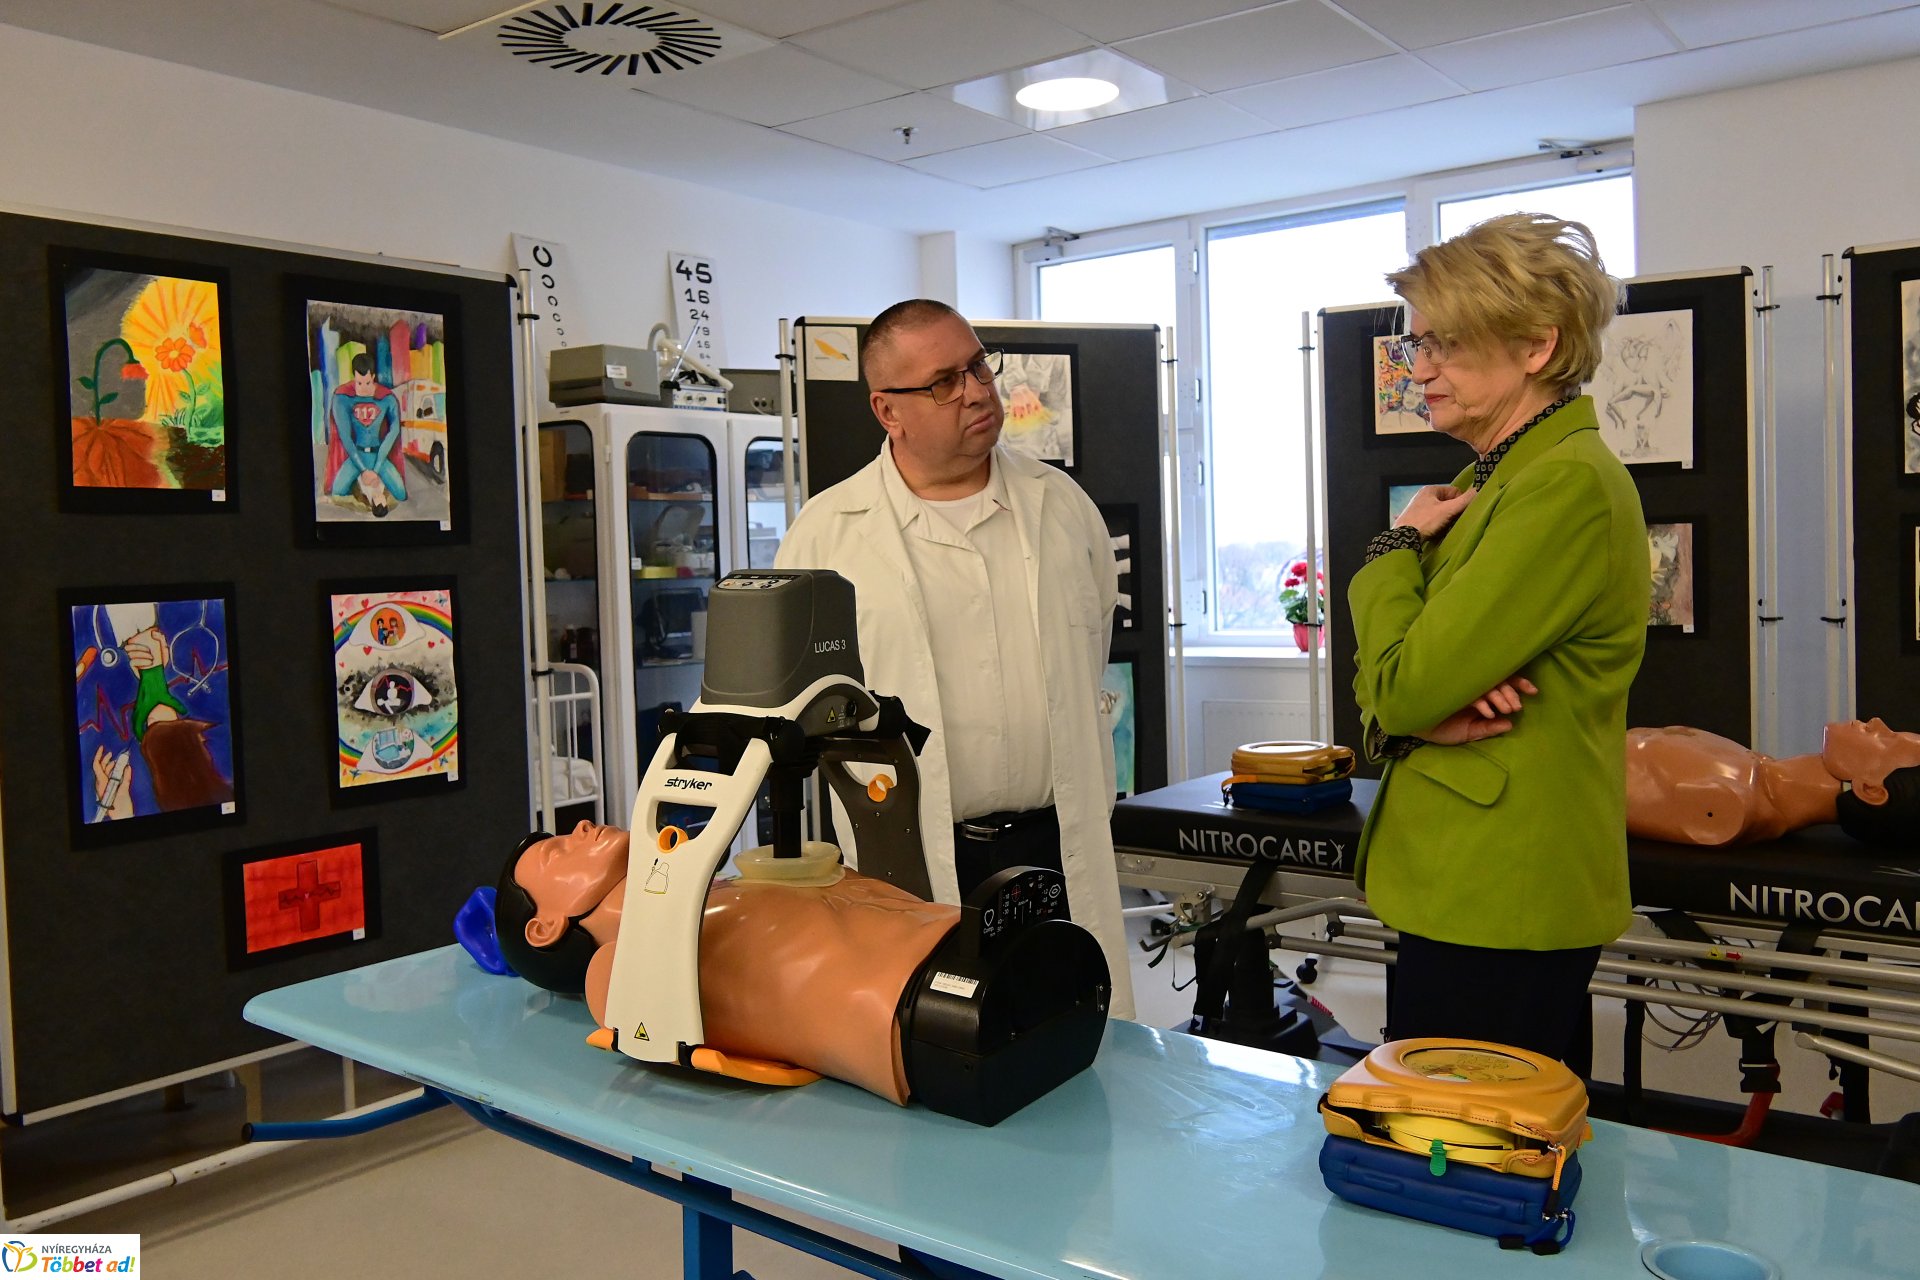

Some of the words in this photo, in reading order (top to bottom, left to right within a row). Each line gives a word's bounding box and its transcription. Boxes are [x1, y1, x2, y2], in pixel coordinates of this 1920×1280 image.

[675, 259, 713, 284] 45
[684, 288, 711, 305] 16
[689, 308, 710, 321] 24
[354, 406, 377, 420] 112
[814, 639, 841, 654] LUCAS
[841, 639, 847, 650] 3
[664, 776, 713, 791] stryker
[1178, 827, 1328, 867] NITROCARE
